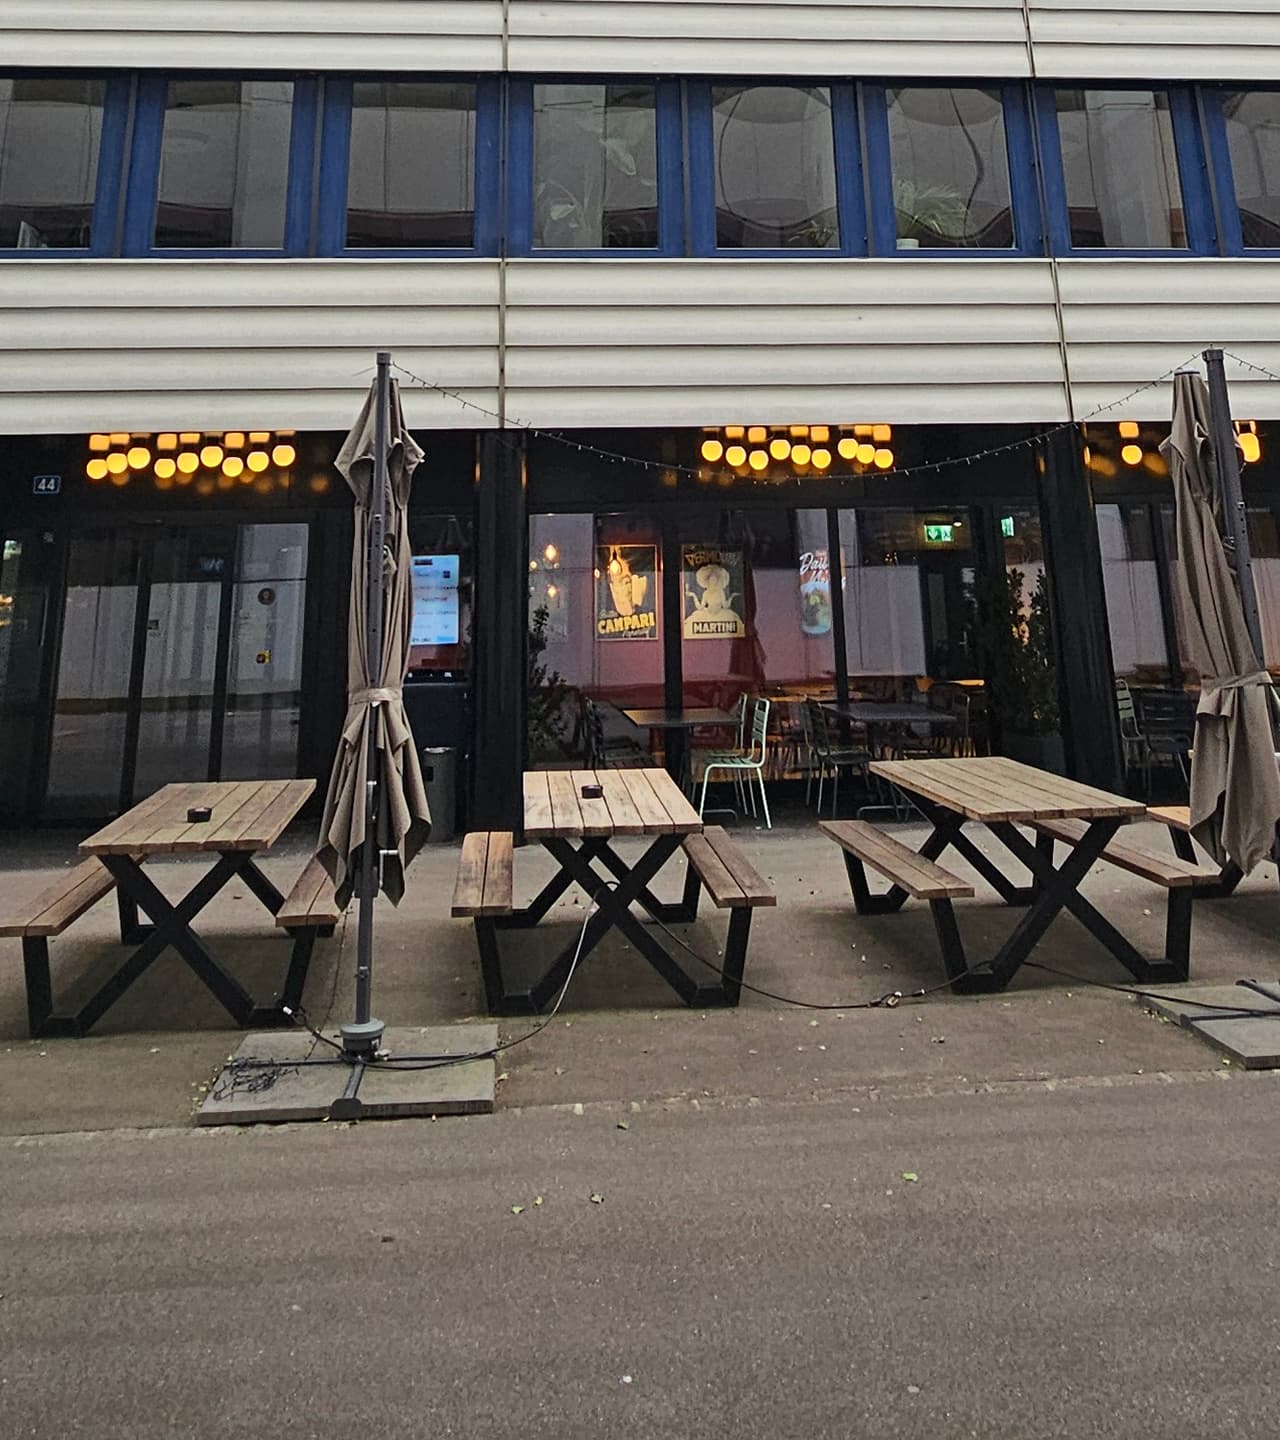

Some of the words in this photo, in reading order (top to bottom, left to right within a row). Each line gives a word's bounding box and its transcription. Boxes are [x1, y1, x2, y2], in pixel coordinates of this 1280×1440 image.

[38, 478, 55, 490] 44
[598, 611, 655, 634] CAMPARI
[693, 621, 737, 634] MARTINI
